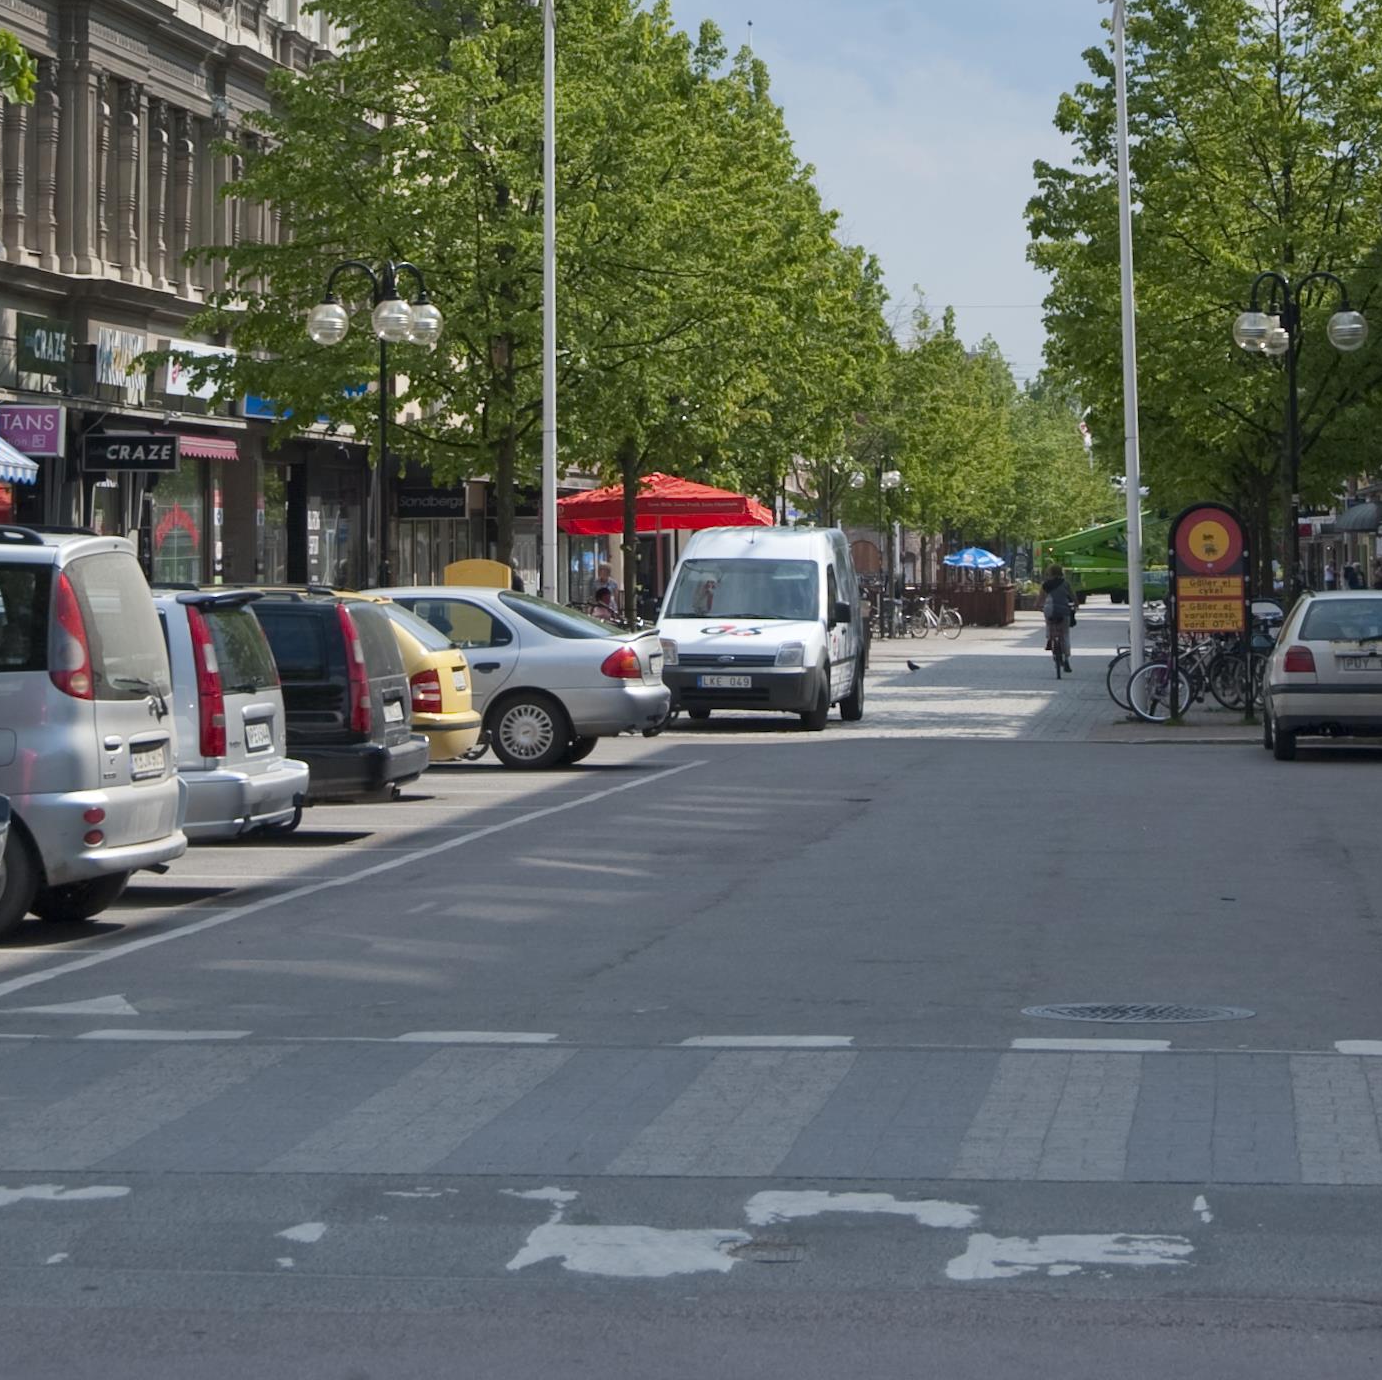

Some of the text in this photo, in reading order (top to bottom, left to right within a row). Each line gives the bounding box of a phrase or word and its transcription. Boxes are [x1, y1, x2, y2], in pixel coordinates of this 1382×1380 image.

[34, 328, 67, 363] CRAZE
[105, 444, 172, 461] CRAZE
[398, 494, 464, 509] Sandbergs
[1189, 578, 1218, 587] Gäller
[1199, 586, 1224, 595] cykel
[1189, 602, 1218, 611] Gäller
[1346, 658, 1370, 669] PUY
[703, 676, 750, 688] LKE 049
